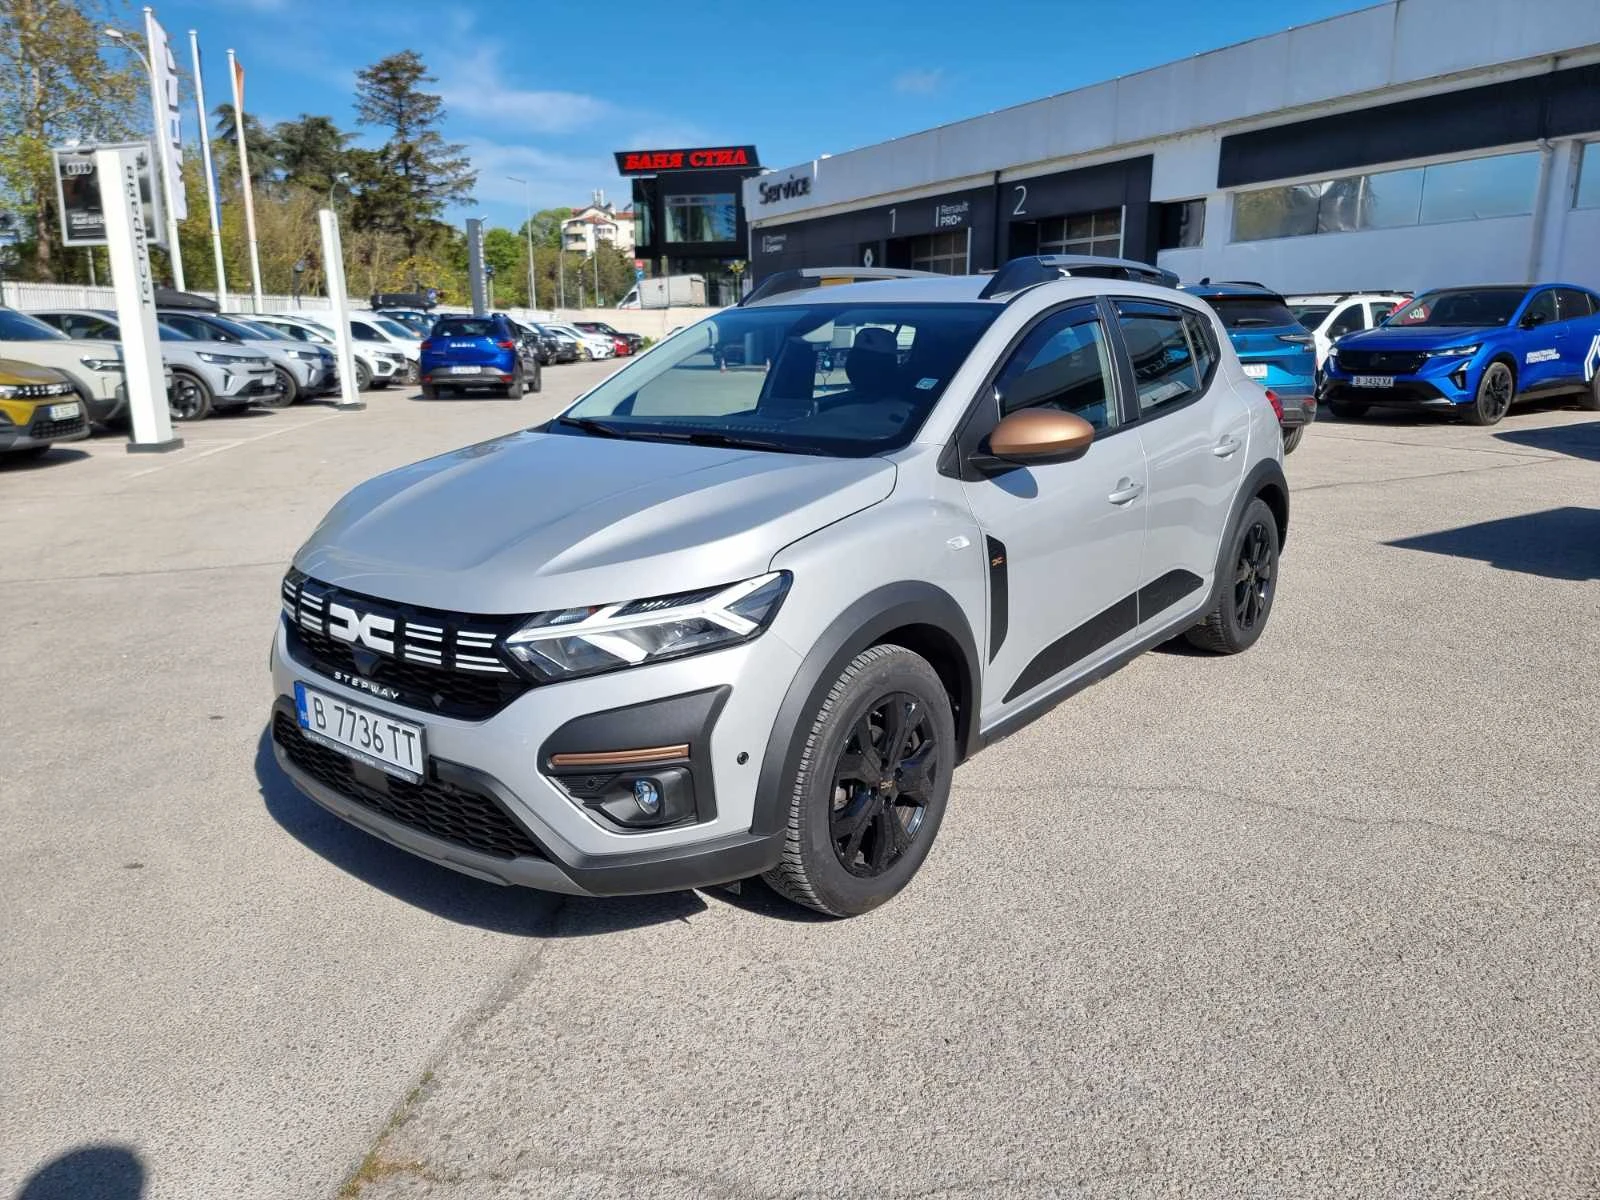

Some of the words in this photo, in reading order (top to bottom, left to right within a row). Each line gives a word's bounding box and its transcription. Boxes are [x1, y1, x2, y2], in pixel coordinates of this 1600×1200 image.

[624, 153, 684, 170] БАНЯ
[759, 174, 811, 204] Service
[1013, 185, 1026, 215] 2
[889, 208, 896, 234] 1
[940, 201, 969, 215] Renault
[940, 215, 962, 227] PRO+
[334, 671, 400, 699] STEPWAY
[313, 696, 326, 730] B
[334, 705, 385, 753] 7736
[387, 724, 416, 766] TT
